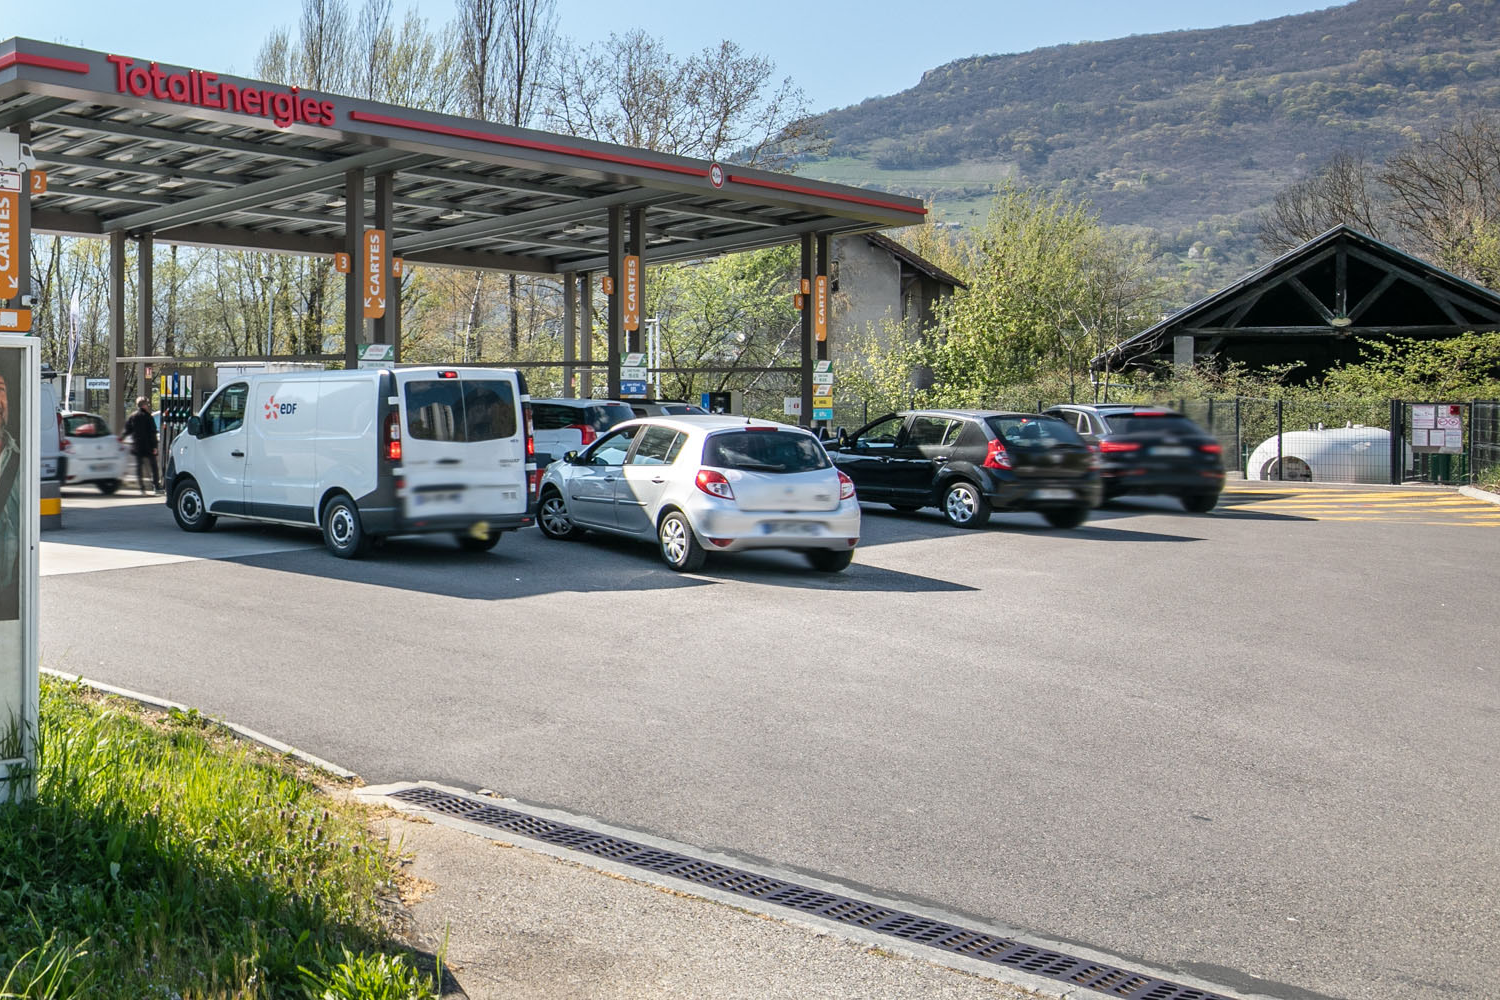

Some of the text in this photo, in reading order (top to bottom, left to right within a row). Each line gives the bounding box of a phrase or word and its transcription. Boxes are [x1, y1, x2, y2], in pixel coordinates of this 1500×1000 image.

[107, 53, 336, 128] TotalEnergies
[33, 175, 42, 190] 2
[341, 256, 348, 269] 3
[370, 234, 380, 296] CARTES
[393, 261, 400, 273] 4
[606, 280, 612, 291] 5
[627, 259, 636, 311] CARTES
